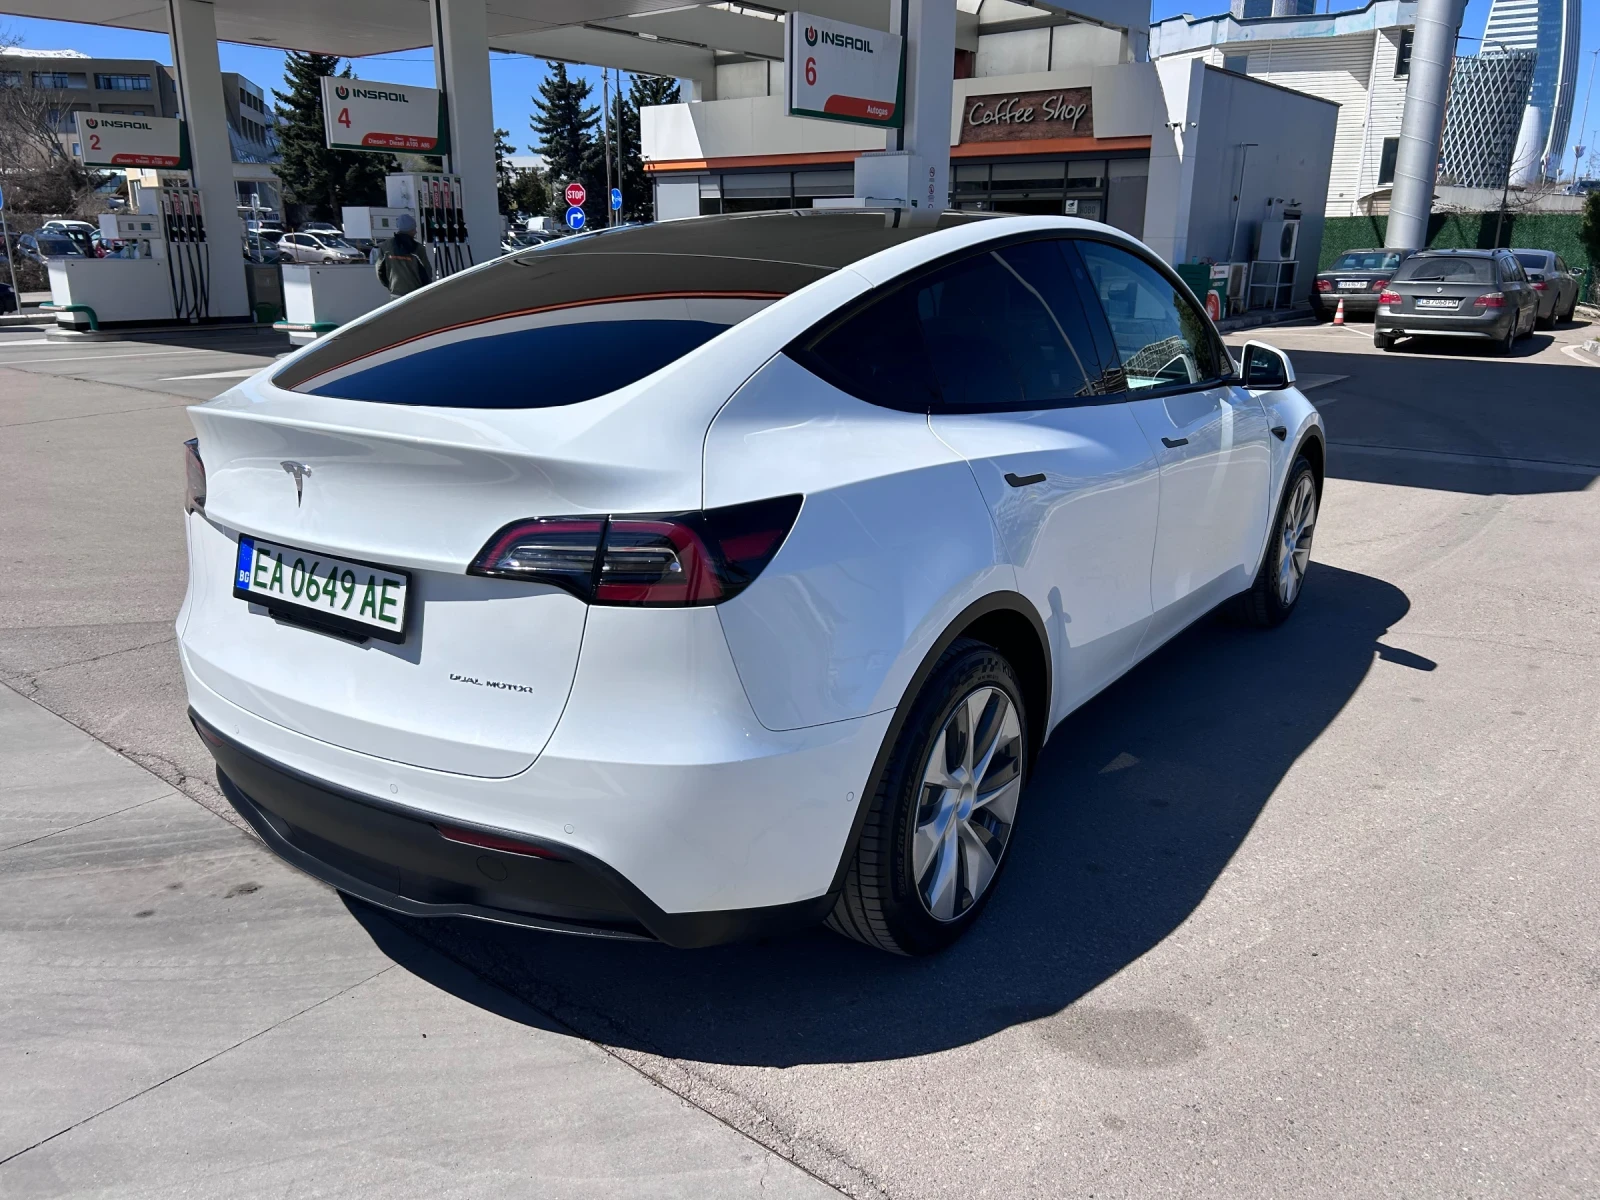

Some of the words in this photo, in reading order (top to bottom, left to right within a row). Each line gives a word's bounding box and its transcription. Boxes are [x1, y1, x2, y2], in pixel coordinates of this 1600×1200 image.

[805, 56, 817, 86] 6
[337, 107, 352, 129] 4
[866, 105, 889, 117] Autogas
[968, 97, 1036, 126] Coffee
[1042, 94, 1087, 130] Shop
[89, 134, 102, 150] 2
[567, 191, 584, 199] STOP
[238, 569, 250, 584] BG
[253, 547, 283, 594] EA
[290, 558, 356, 611] 0649
[359, 575, 400, 625] AE
[449, 673, 483, 686] DUAL
[486, 681, 534, 694] MOTOR
